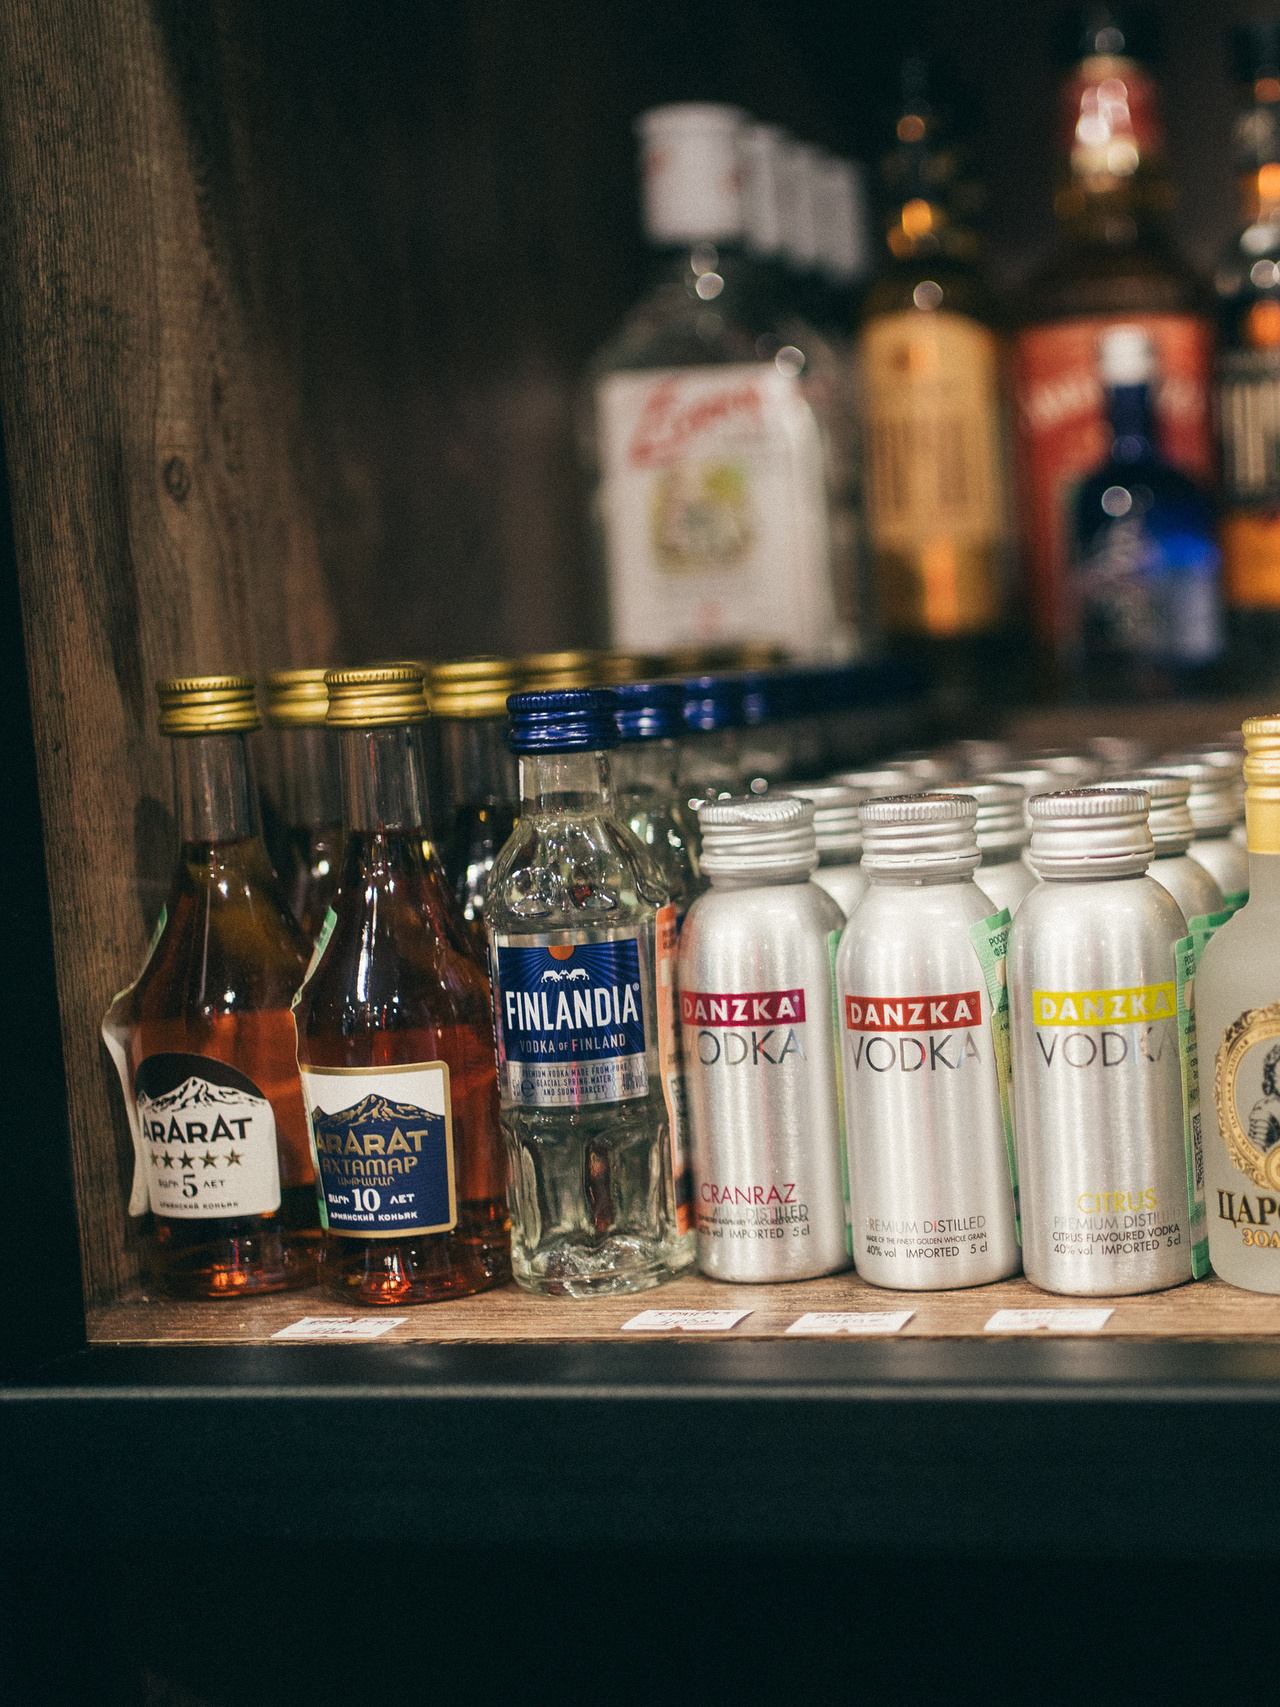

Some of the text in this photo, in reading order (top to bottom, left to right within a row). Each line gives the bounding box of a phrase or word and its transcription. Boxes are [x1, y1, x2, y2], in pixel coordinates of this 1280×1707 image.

[684, 996, 797, 1022] DANZKA
[850, 999, 973, 1026] DANZKA
[1040, 990, 1169, 1021] DANZKA
[520, 1033, 627, 1054] VODKA OF FINLAND
[697, 1028, 808, 1066] ODKA
[850, 1032, 981, 1073] VODKA
[1036, 1023, 1179, 1068] VODKA
[591, 1064, 609, 1075] FROM
[543, 1088, 555, 1096] AND
[143, 1113, 253, 1143] ARARAT
[316, 1126, 428, 1156] ARARAT
[321, 1156, 418, 1176] АХТАМАР
[182, 1173, 198, 1199] 5
[700, 1182, 797, 1205] CRANRAZ
[351, 1187, 381, 1212] 10
[389, 1193, 415, 1204] ЛЕТ
[1077, 1187, 1157, 1214] CITRUS
[378, 1211, 418, 1221] КОНЬЯК
[923, 1215, 987, 1234] DISTILLED
[729, 1228, 784, 1239] IMPORTED
[916, 1237, 943, 1246] GOLDEN
[944, 1235, 967, 1244] WHOLE
[967, 1232, 987, 1241] GRAIN
[1052, 1223, 1180, 1243] CITRUS FLAVOURED VODKA
[866, 1240, 988, 1259] 40% vol IMPORTED 5 cl
[1053, 1243, 1076, 1256] 40%
[1078, 1244, 1093, 1256] vol
[1101, 1240, 1160, 1255] IMPORTED
